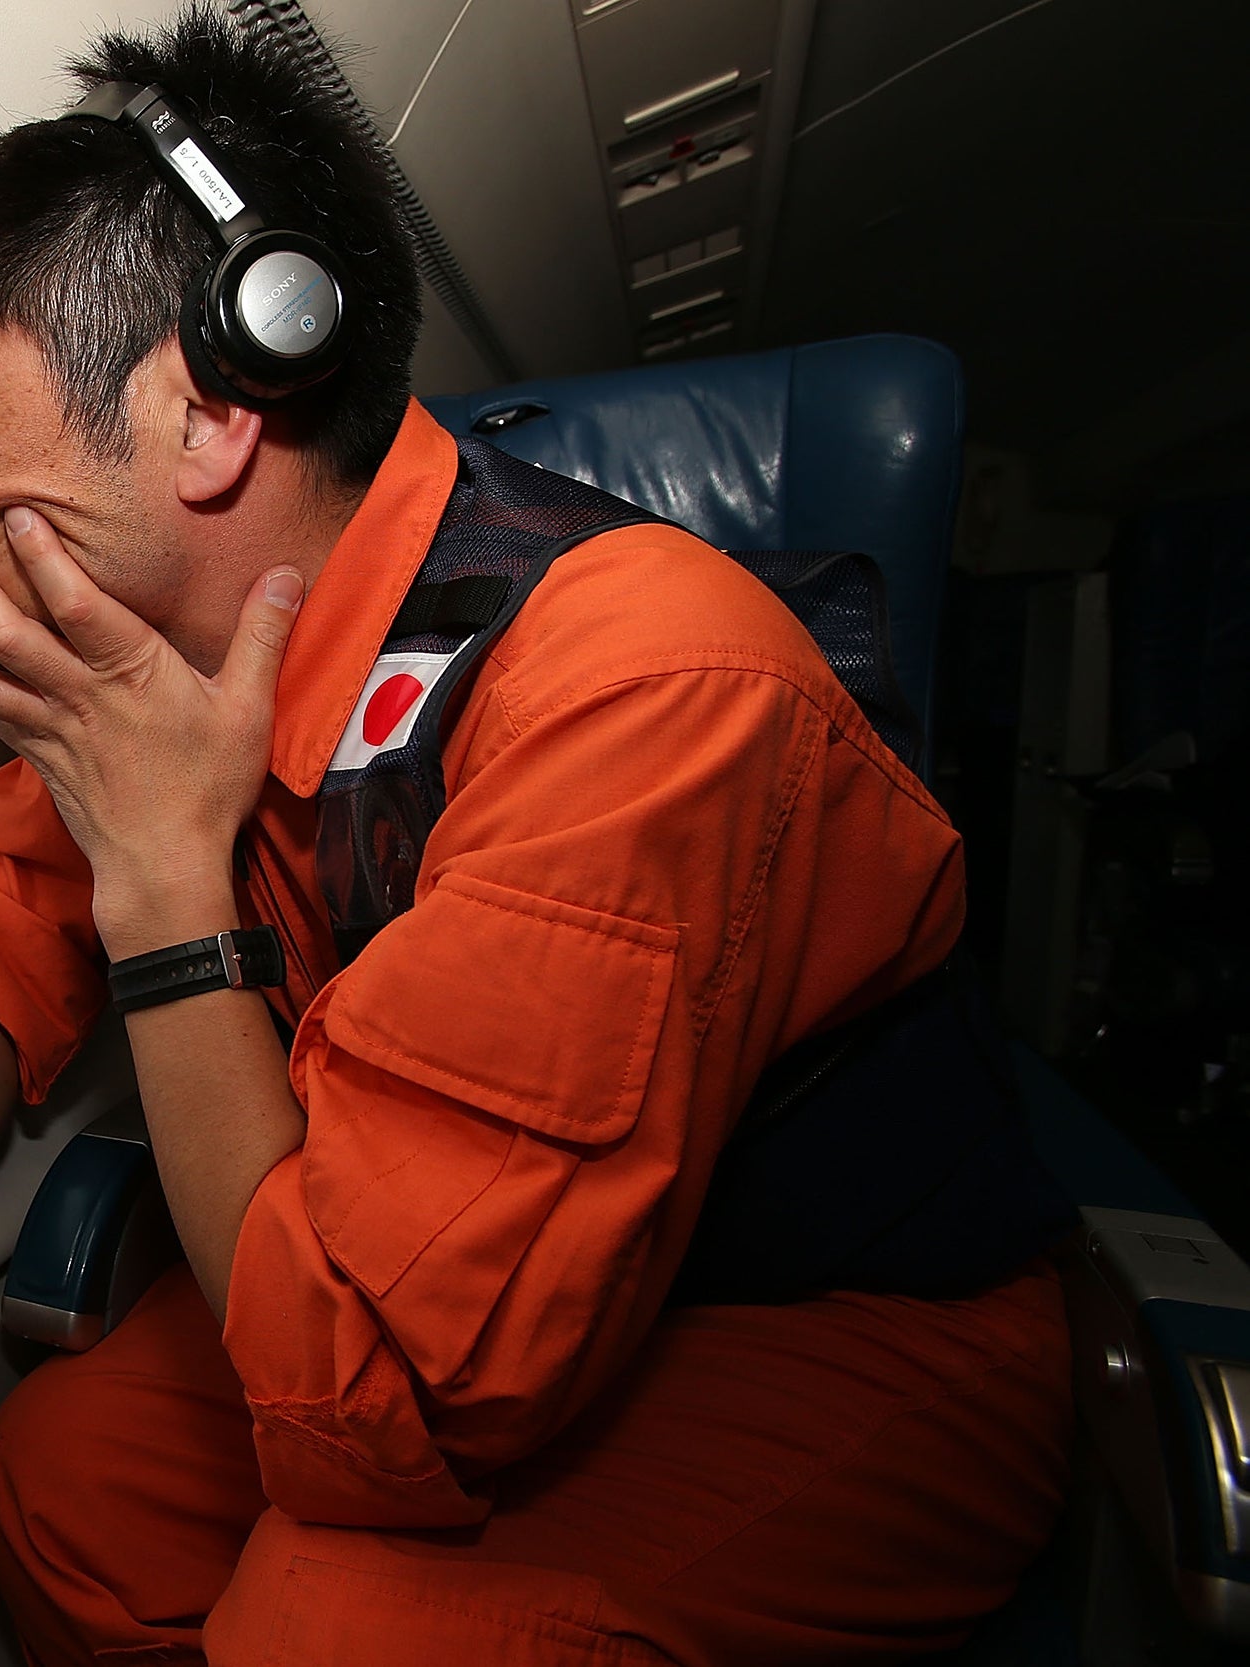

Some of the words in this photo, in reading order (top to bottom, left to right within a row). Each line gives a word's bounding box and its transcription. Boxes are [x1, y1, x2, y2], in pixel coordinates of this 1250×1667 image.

[199, 169, 232, 209] LAJ500
[262, 272, 297, 306] SONY
[303, 319, 314, 330] R
